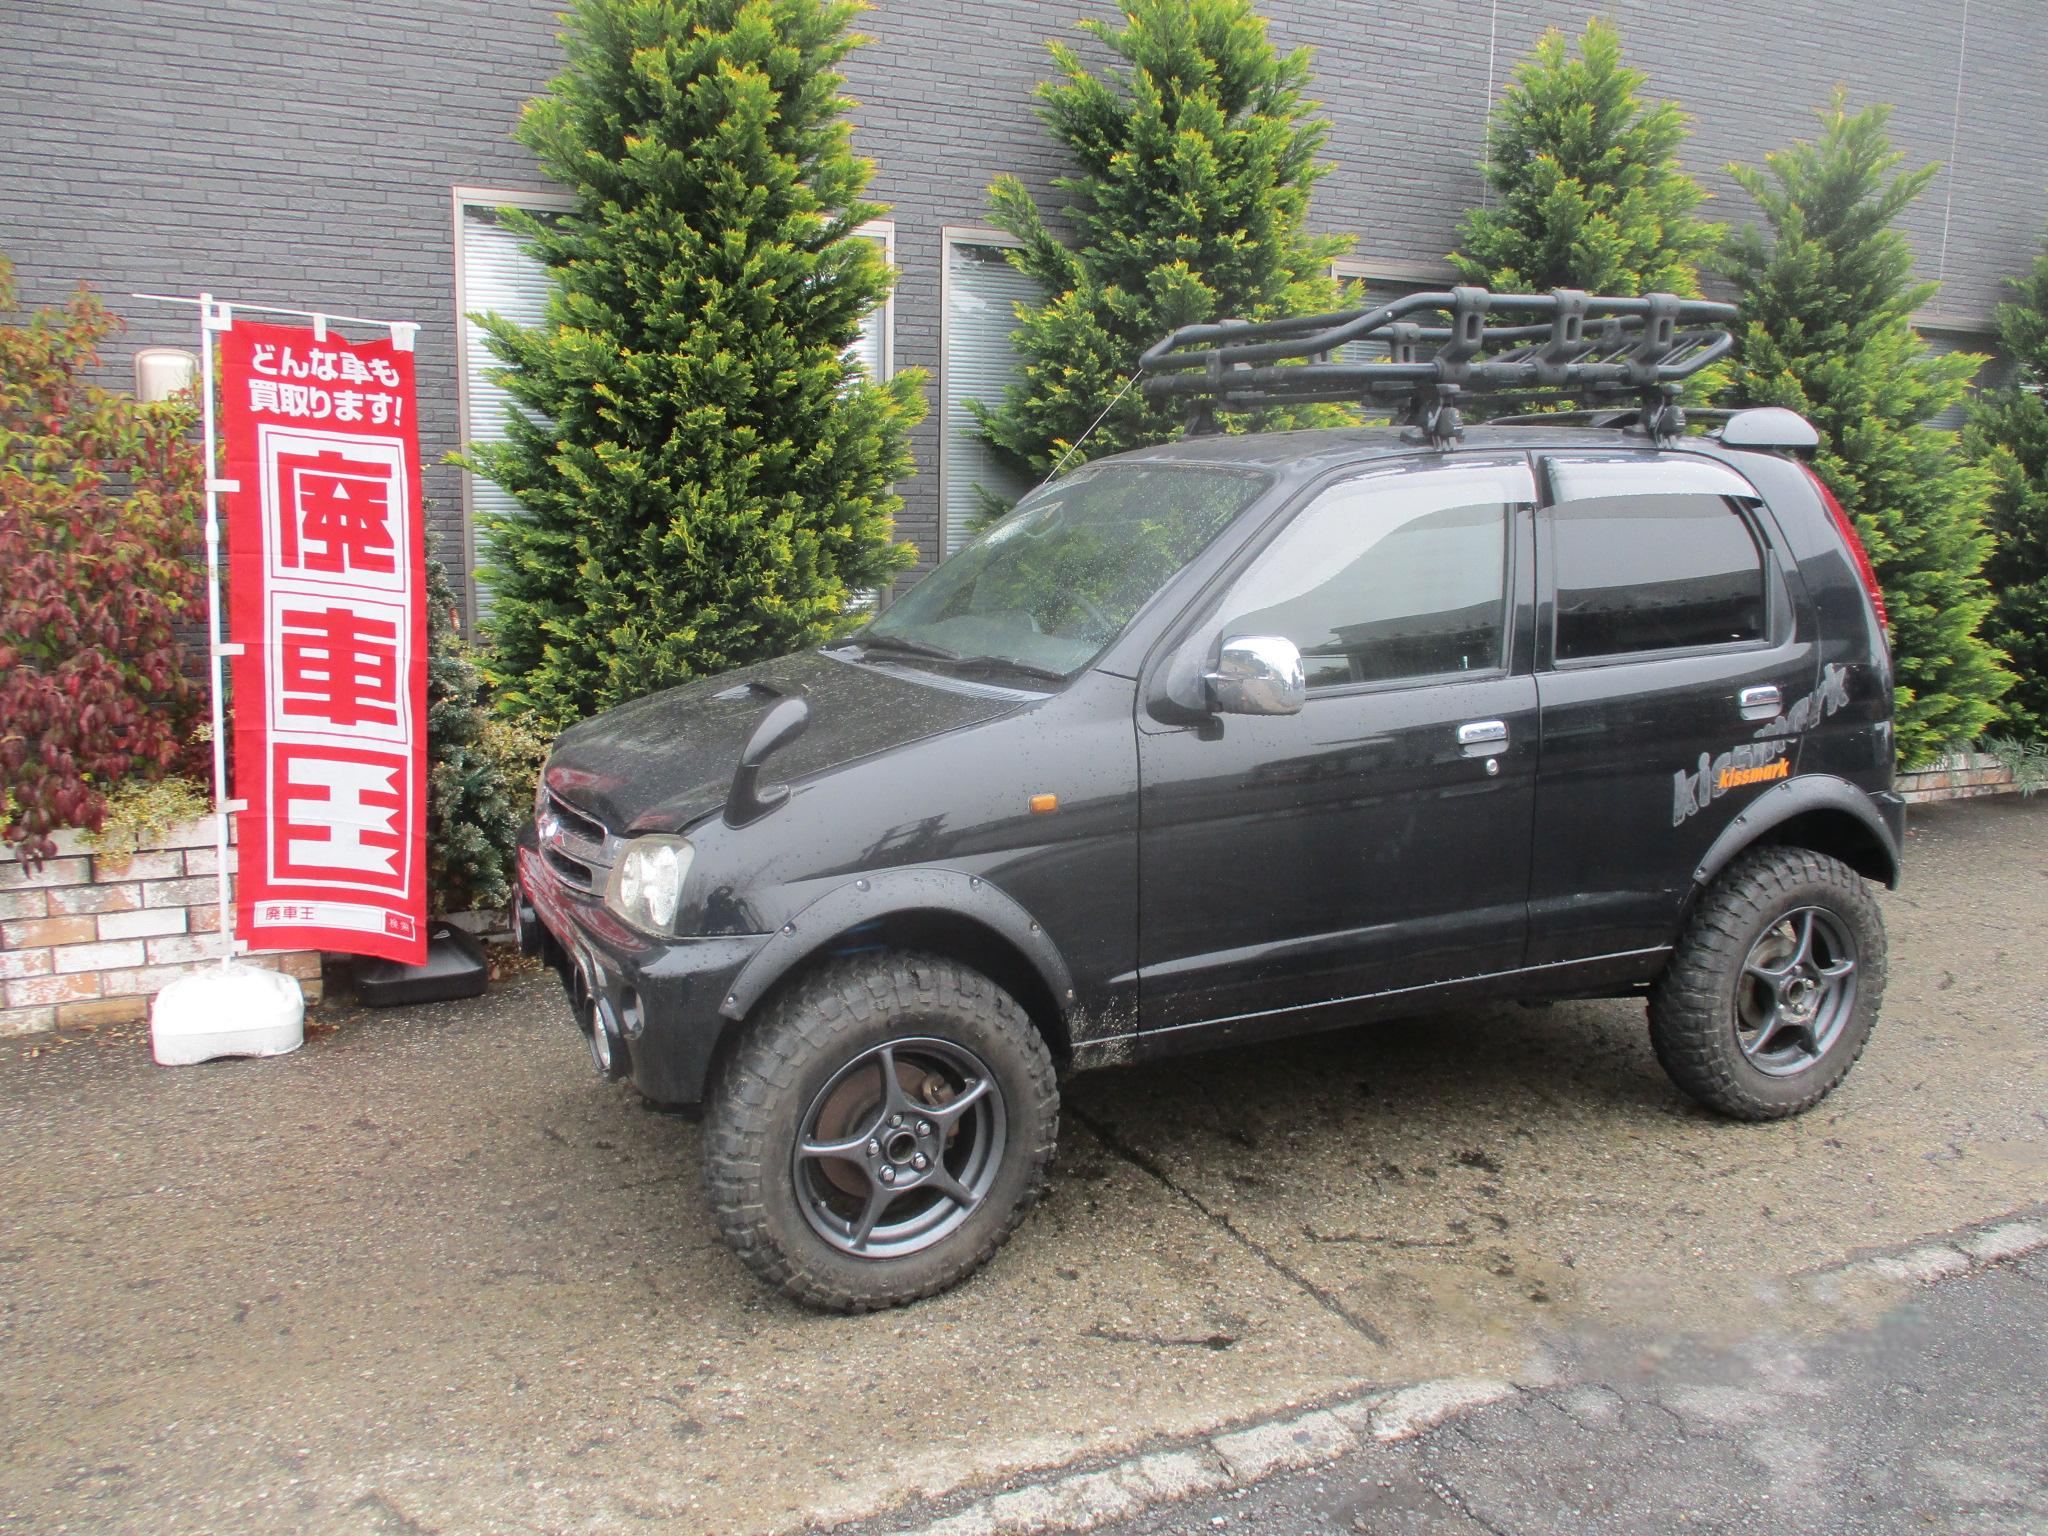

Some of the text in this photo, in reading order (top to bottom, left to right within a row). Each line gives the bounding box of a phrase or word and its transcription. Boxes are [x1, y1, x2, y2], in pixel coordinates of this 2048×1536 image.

[252, 343, 400, 387] どんな車も
[248, 379, 403, 427] 買取ります!
[266, 906, 315, 920] 廃車王
